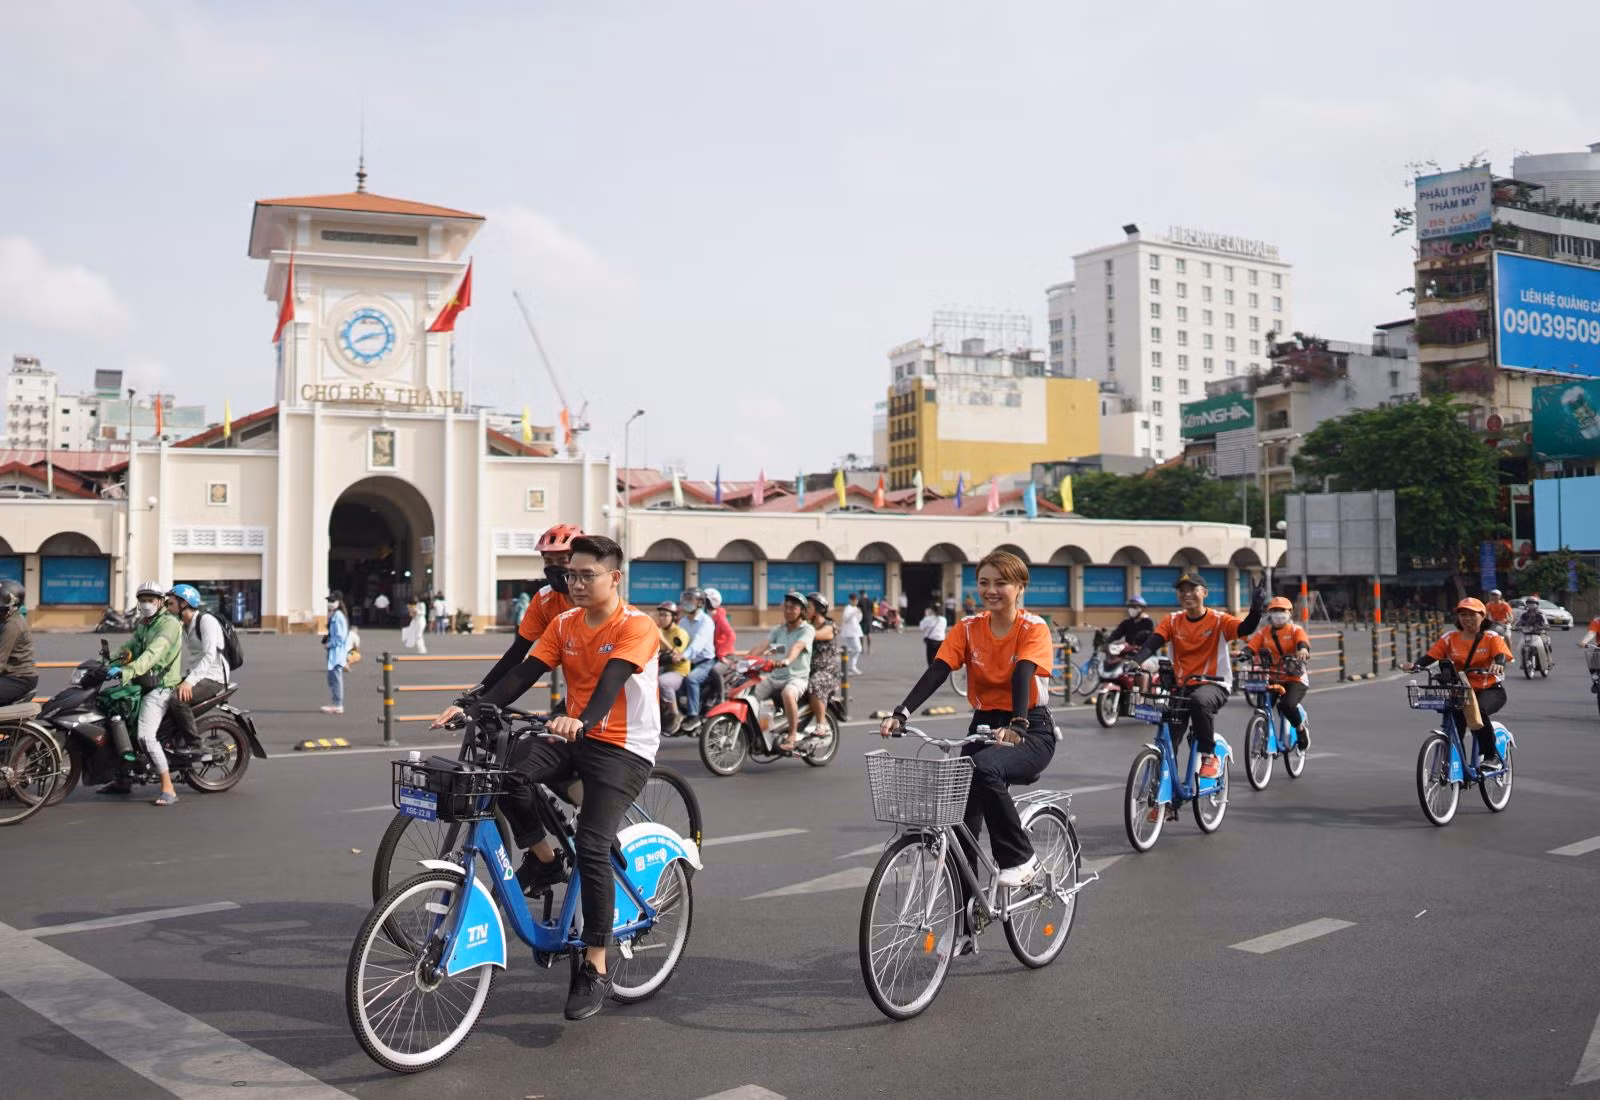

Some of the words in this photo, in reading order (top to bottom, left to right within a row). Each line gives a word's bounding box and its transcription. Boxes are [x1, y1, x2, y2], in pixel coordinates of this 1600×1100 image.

[1520, 287, 1541, 304] LIÊN
[1543, 291, 1556, 309] HỆ
[467, 922, 489, 943] TN
